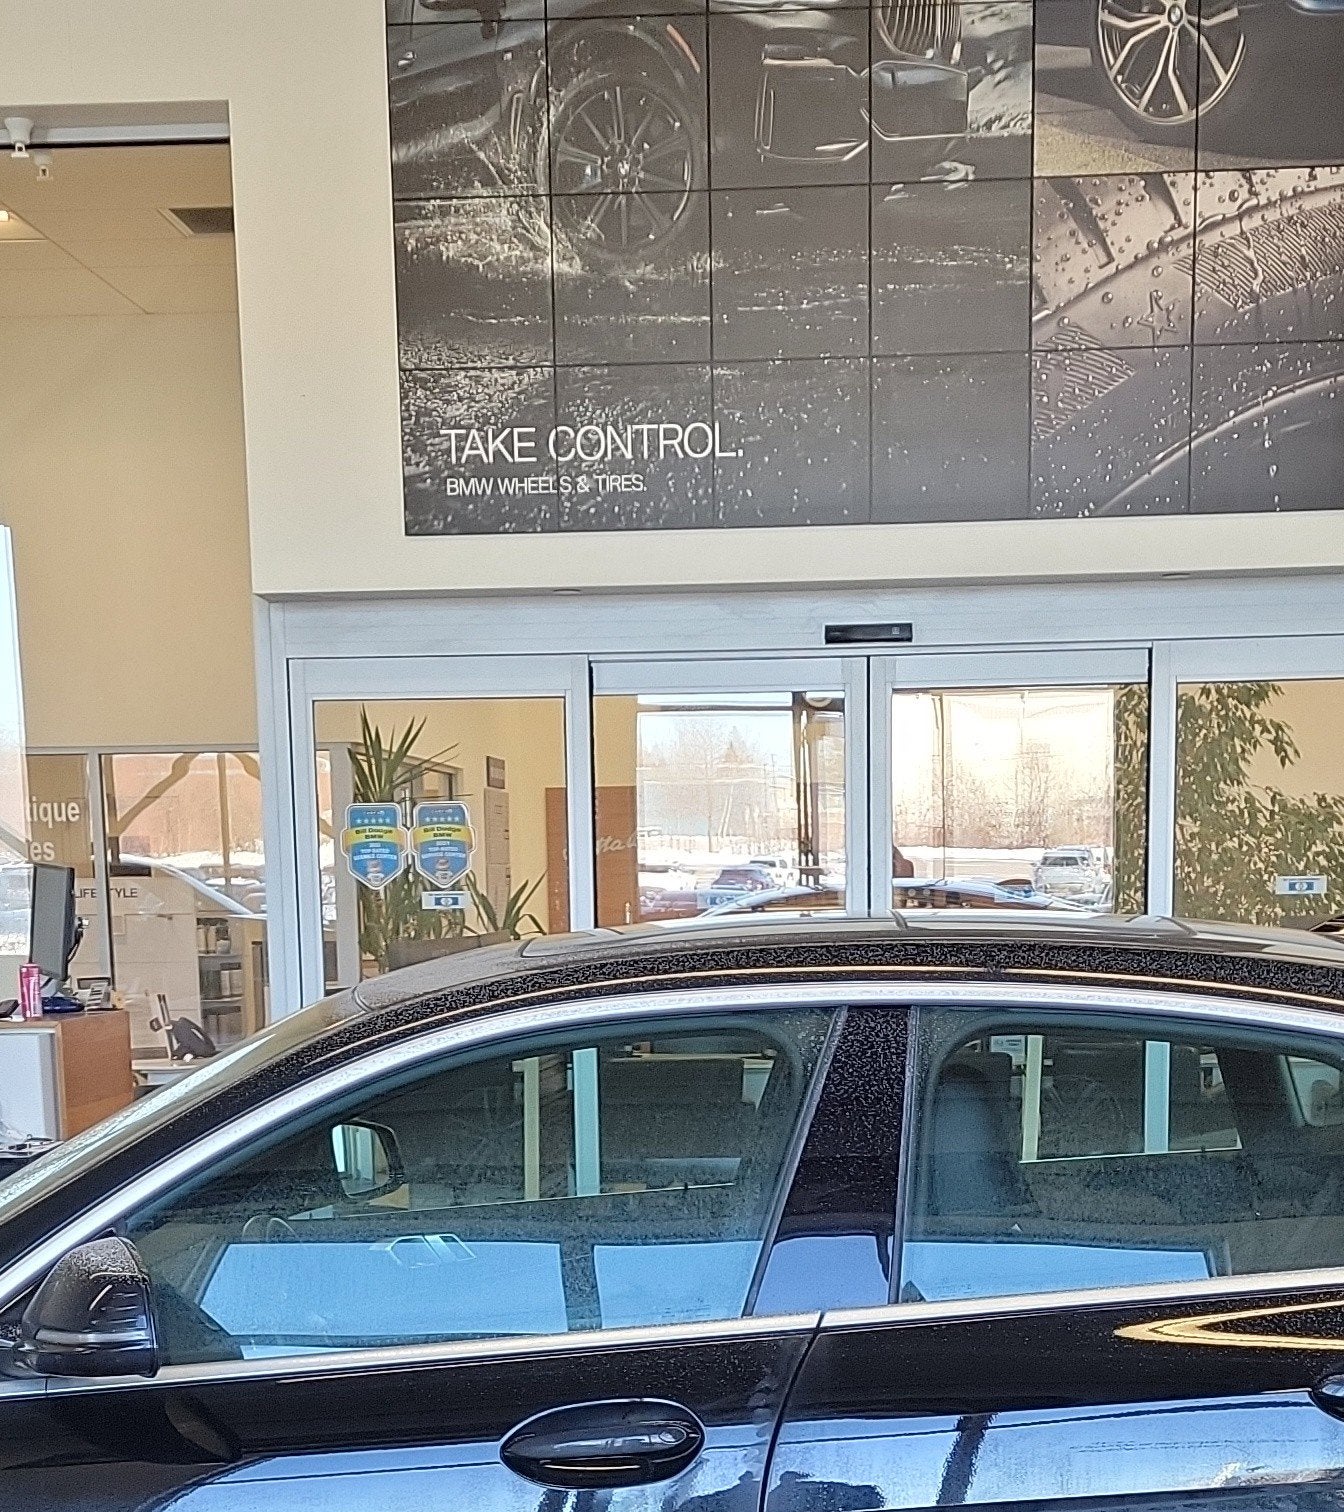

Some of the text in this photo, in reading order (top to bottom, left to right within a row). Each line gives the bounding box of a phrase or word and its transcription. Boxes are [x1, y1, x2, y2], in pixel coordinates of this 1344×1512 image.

[439, 420, 744, 465] TAKE CONTROL.
[446, 474, 648, 496] BMW WHEELS & TIRES.
[27, 795, 81, 829] ique
[368, 827, 394, 835] Dodge
[436, 826, 462, 834] Dodge
